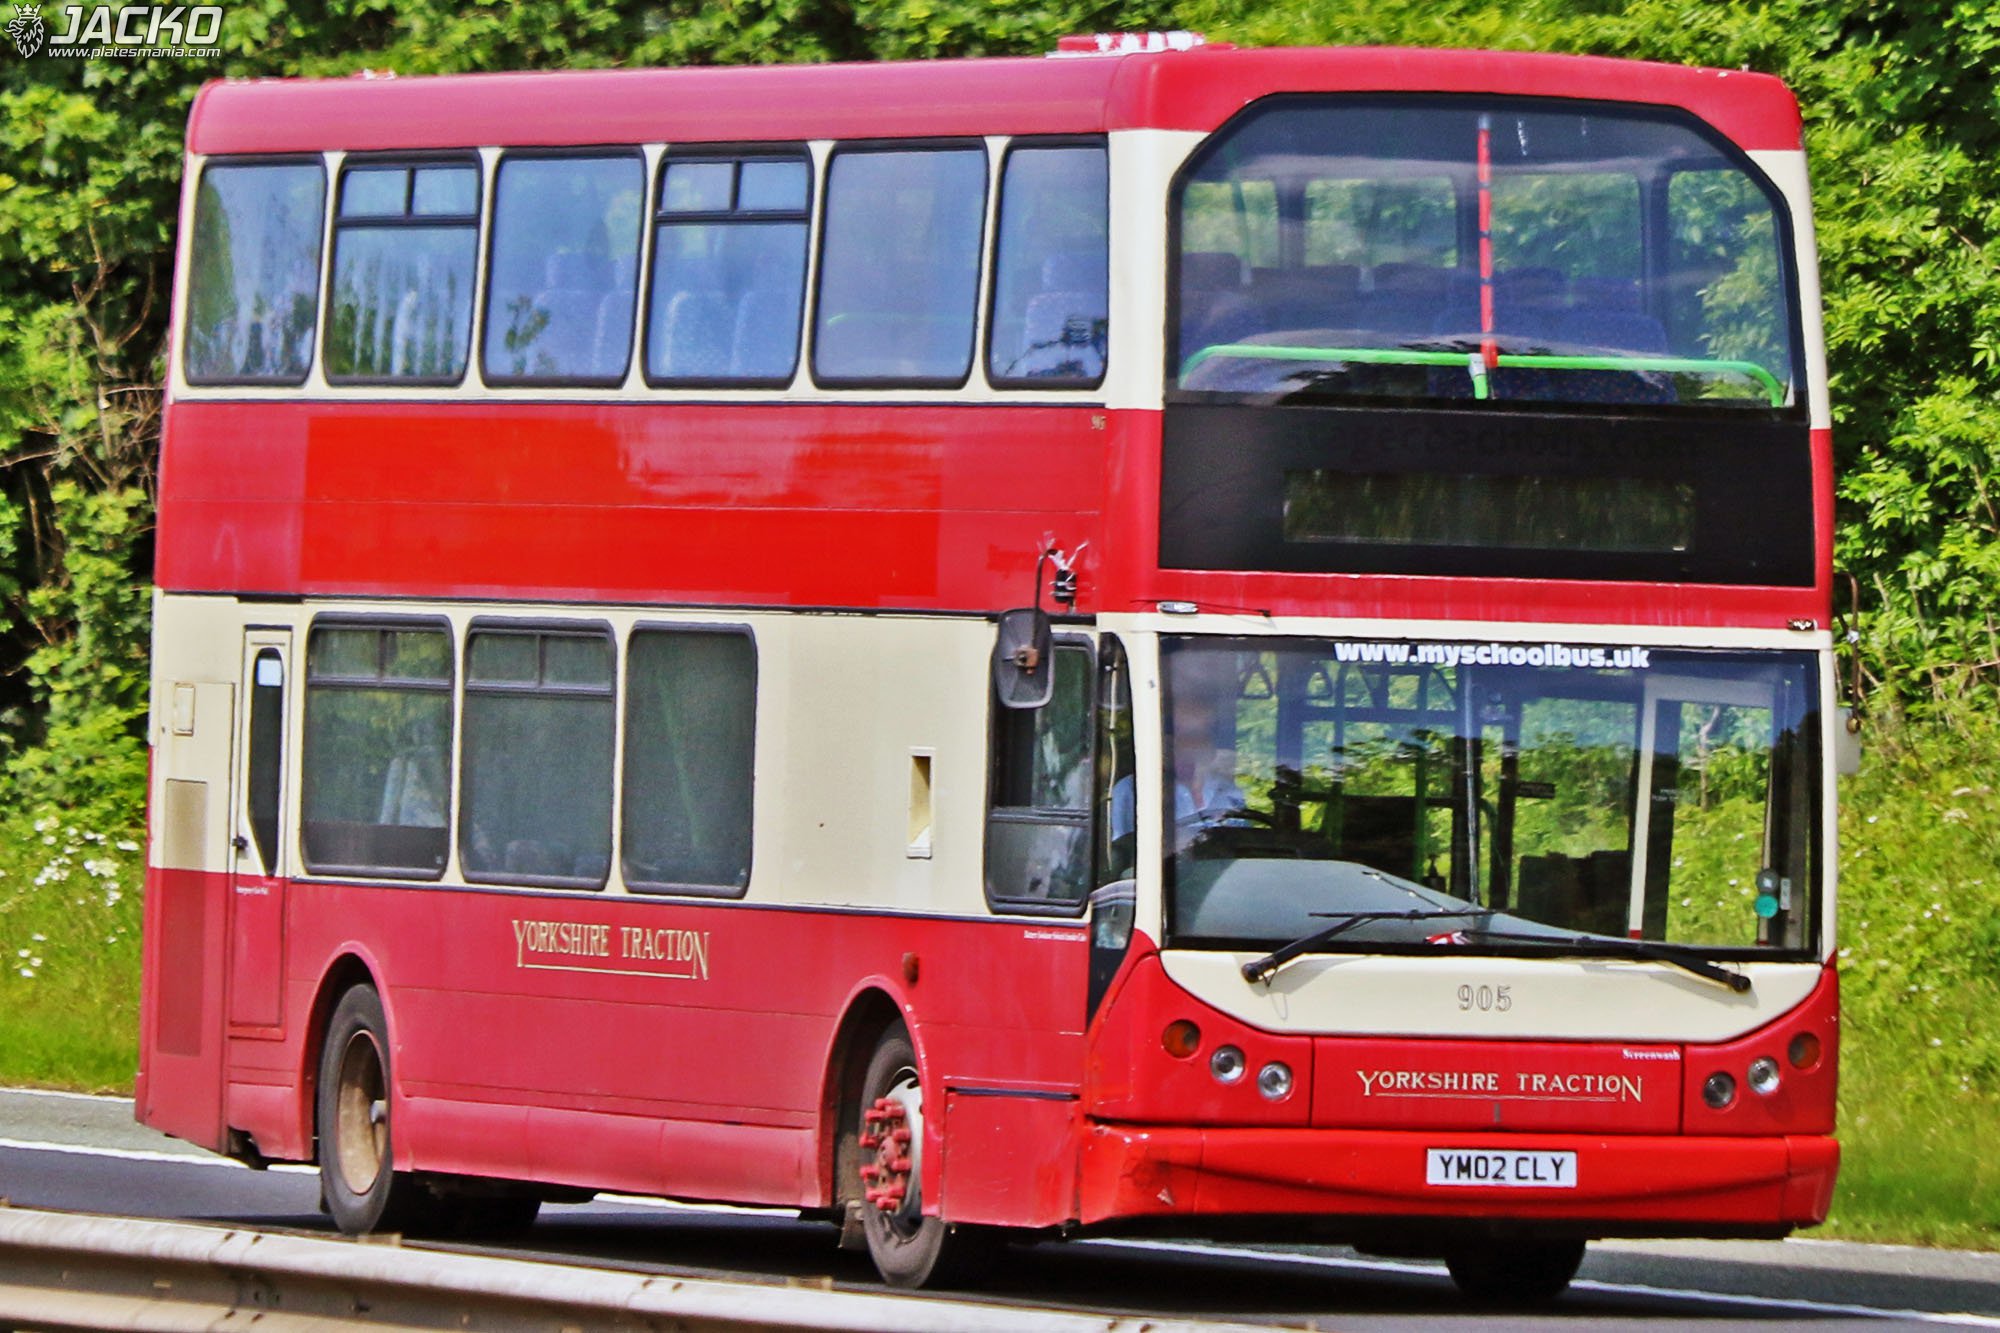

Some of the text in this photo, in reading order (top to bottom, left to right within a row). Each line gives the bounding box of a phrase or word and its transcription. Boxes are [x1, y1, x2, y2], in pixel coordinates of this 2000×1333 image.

[1334, 642, 1650, 669] www.myschoolbus.uk
[512, 919, 710, 980] YORKSHIRE TRACTION
[1457, 984, 1513, 1012] 905
[1356, 1070, 1643, 1102] YORKSHIRE TRACTION
[1440, 1154, 1565, 1181] YM02 CLY
